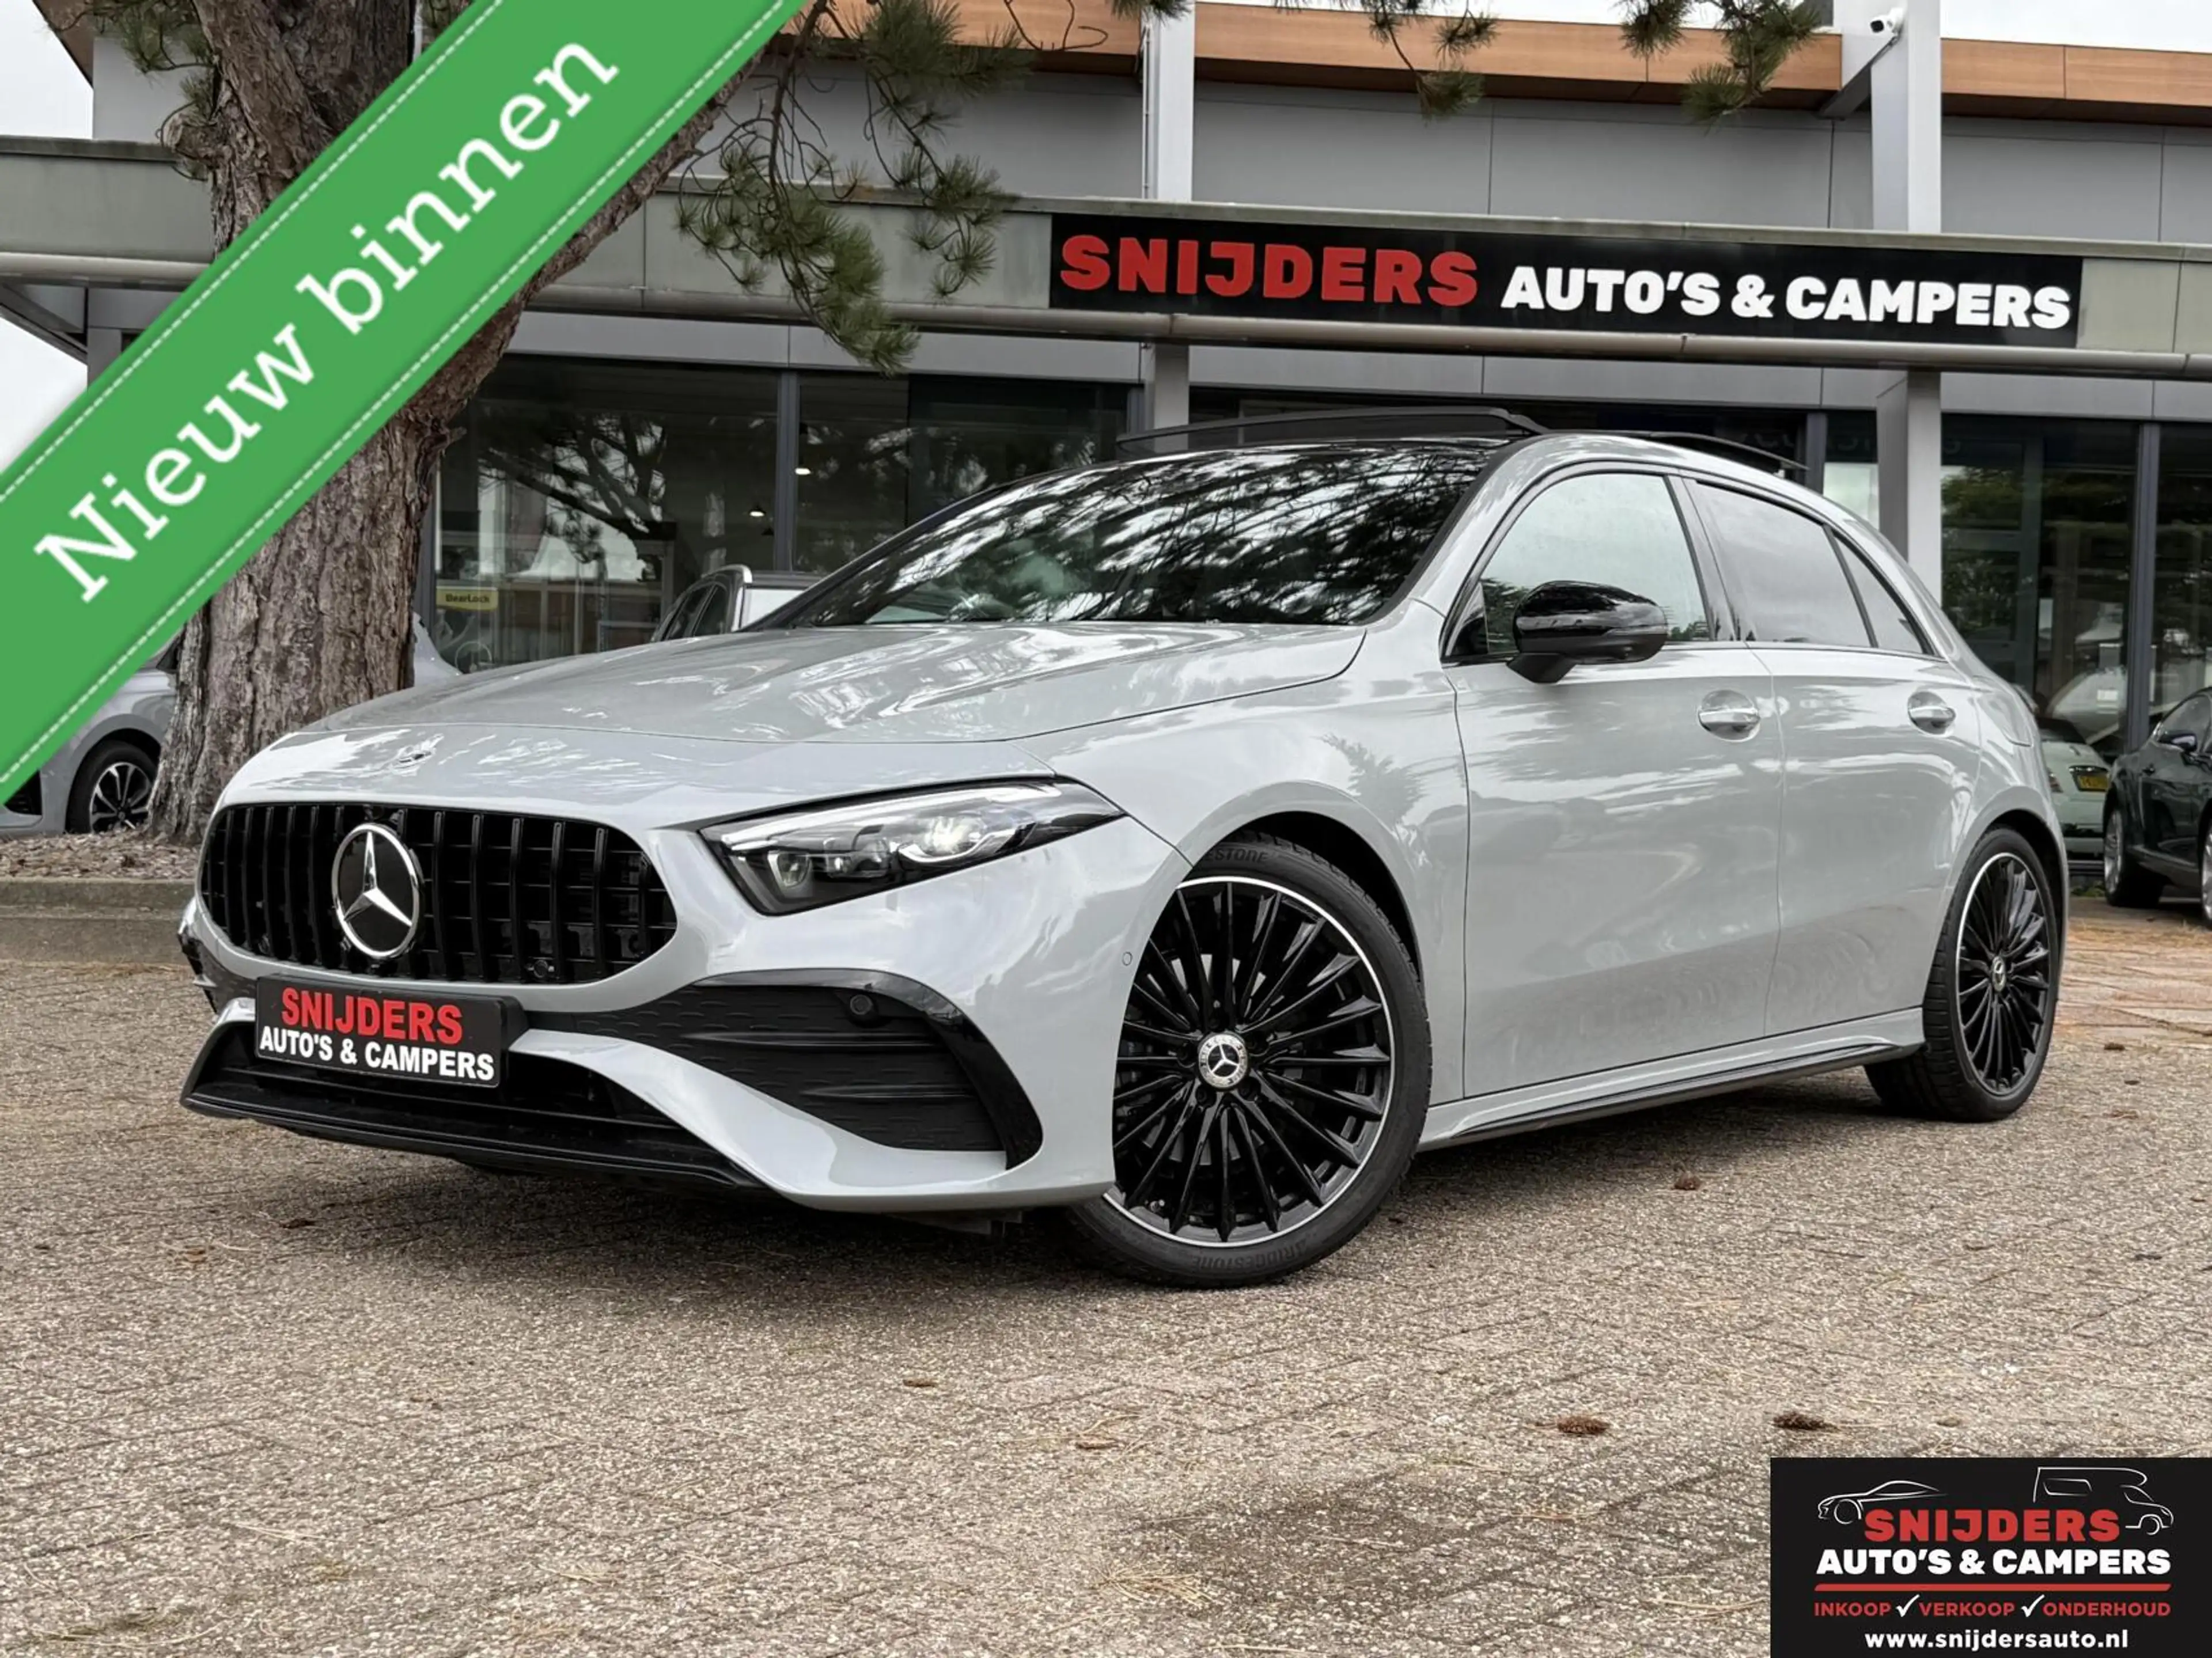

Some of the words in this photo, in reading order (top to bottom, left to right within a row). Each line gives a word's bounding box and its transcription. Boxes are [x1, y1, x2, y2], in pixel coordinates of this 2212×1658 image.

[1060, 234, 1479, 307] SNIJDERS
[1500, 265, 1721, 316] AUTO'S
[1730, 274, 1775, 318] &
[1785, 276, 2071, 329] CAMPERS
[281, 987, 464, 1045] SNIJDERS
[259, 1026, 333, 1061] AUTO'S
[339, 1038, 358, 1065] &
[365, 1041, 495, 1081] CAMPERS
